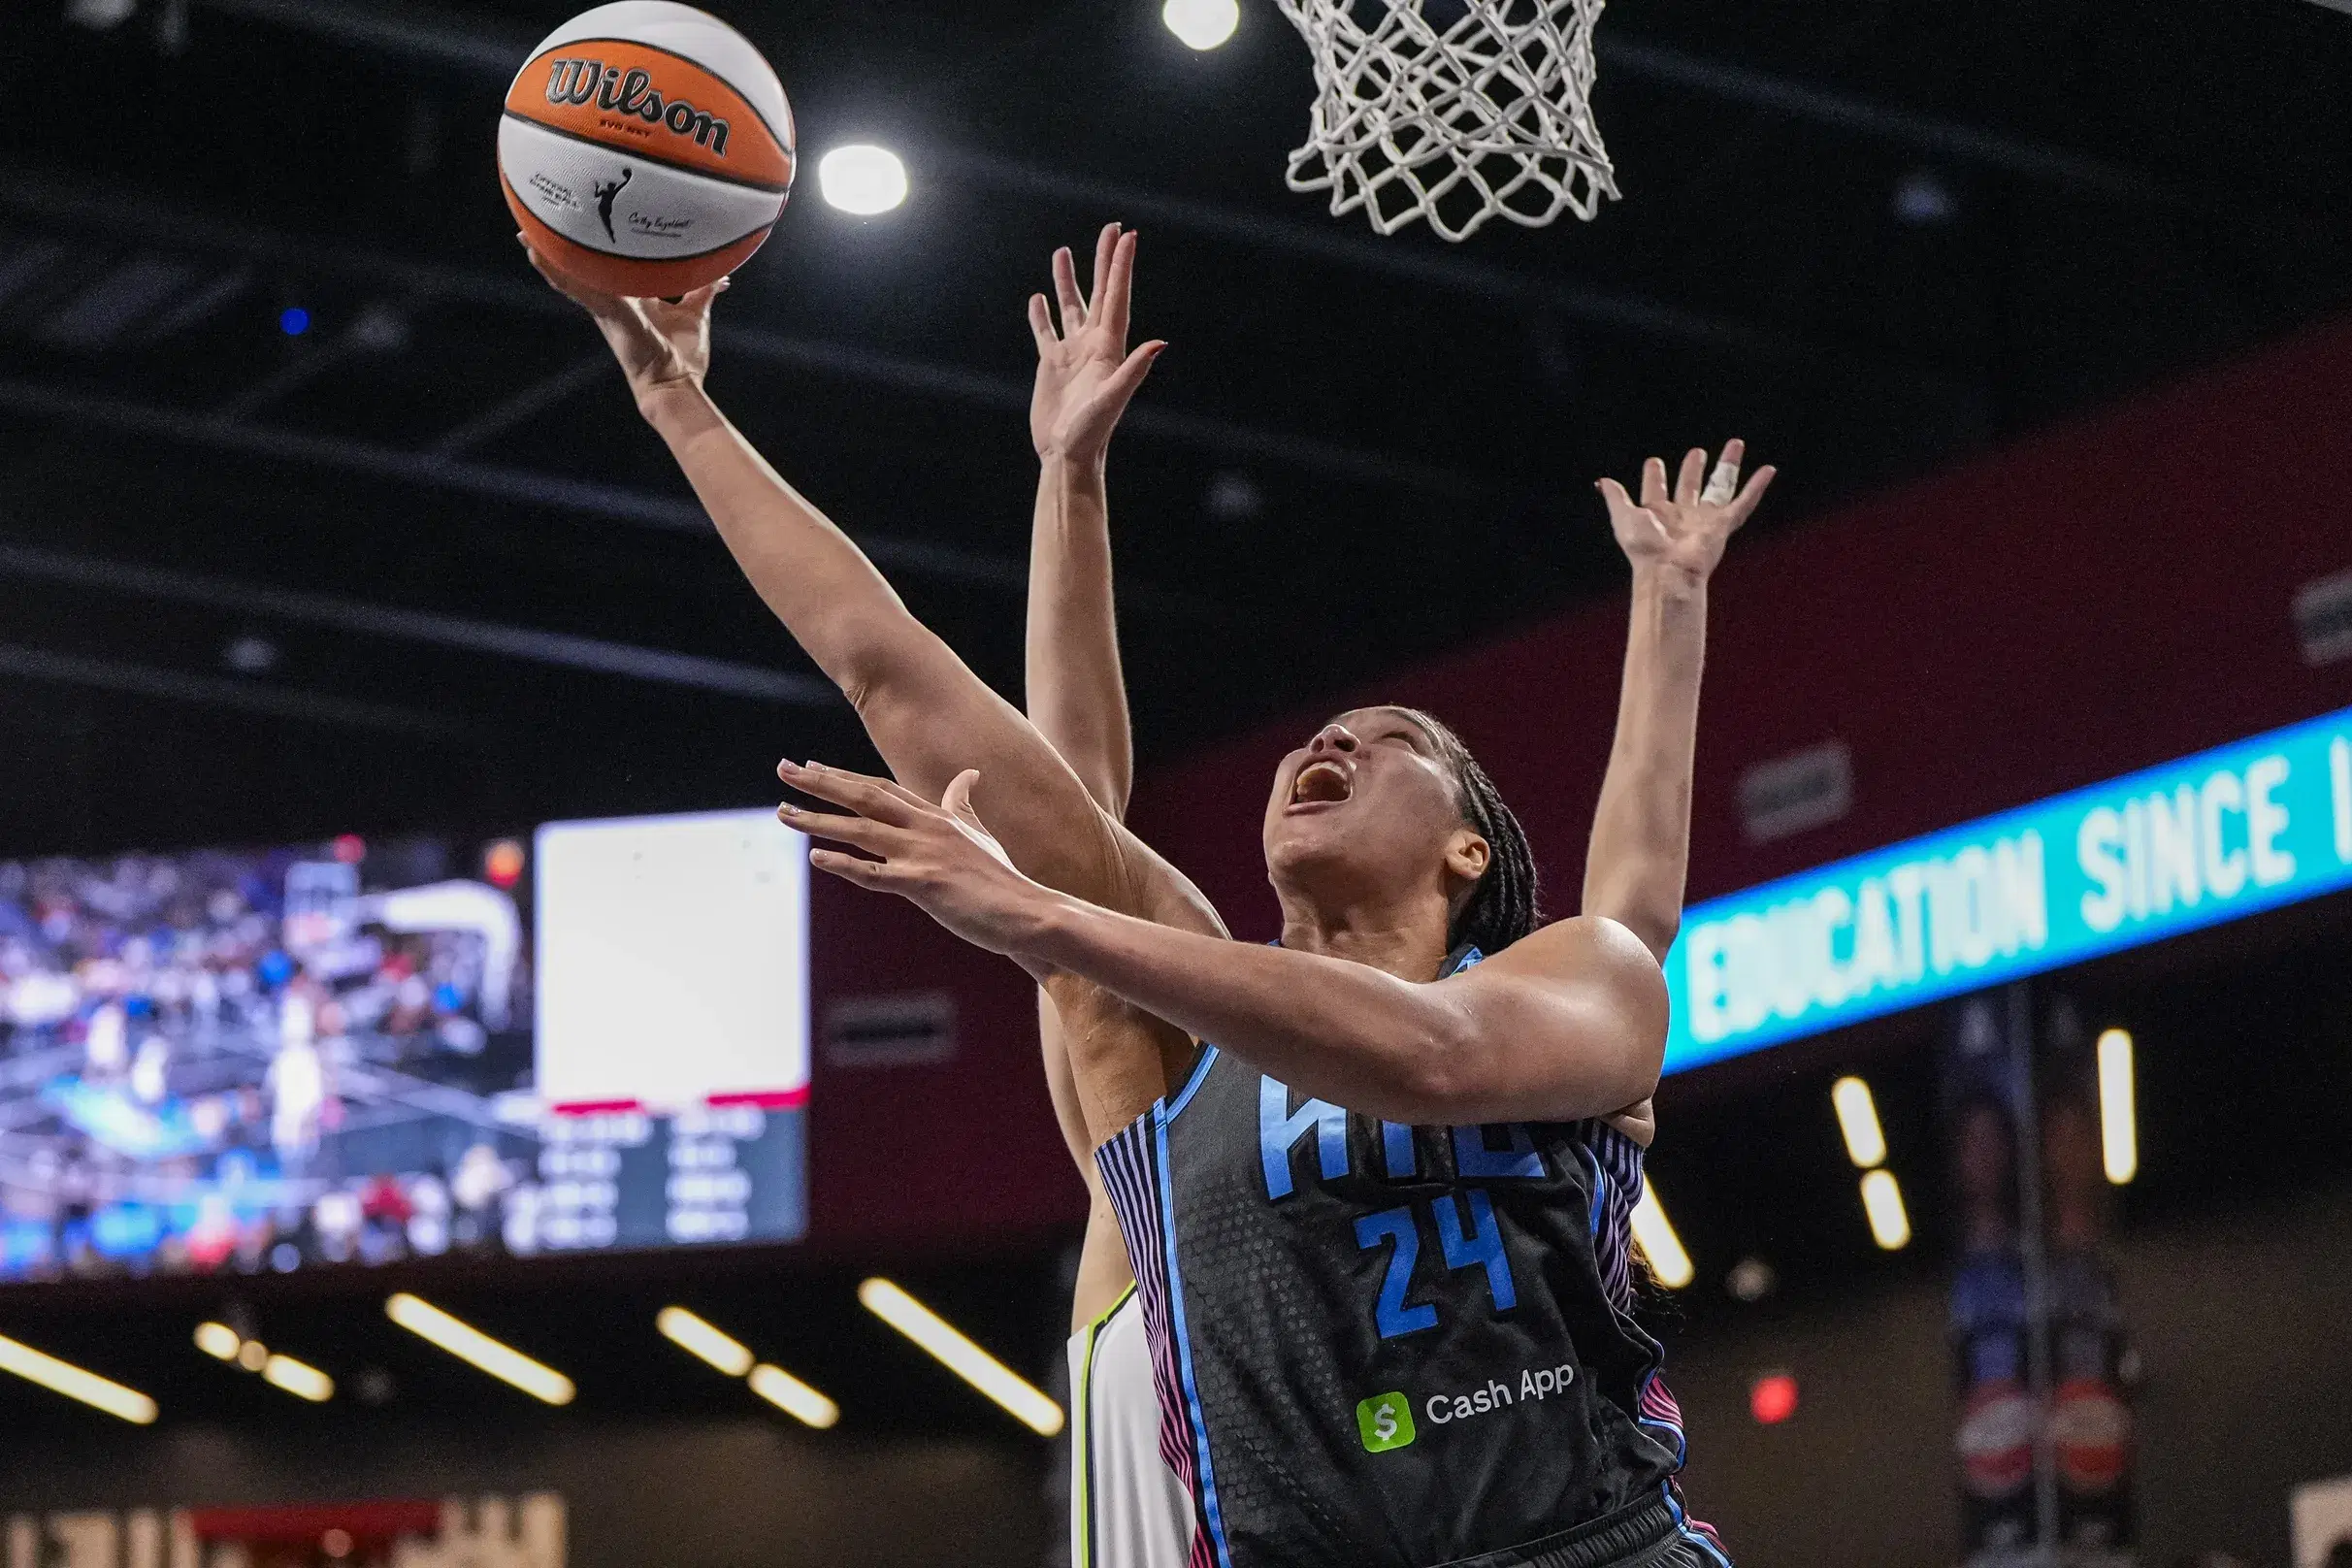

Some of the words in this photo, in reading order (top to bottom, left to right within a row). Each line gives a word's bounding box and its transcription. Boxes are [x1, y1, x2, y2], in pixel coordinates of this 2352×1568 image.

[545, 58, 730, 157] Wilson
[1685, 827, 2048, 1044] EDUCATION
[2076, 754, 2297, 933] SINCE
[1354, 1189, 1518, 1340] 24
[1425, 1379, 1513, 1424] Cash
[1519, 1364, 1574, 1401] App
